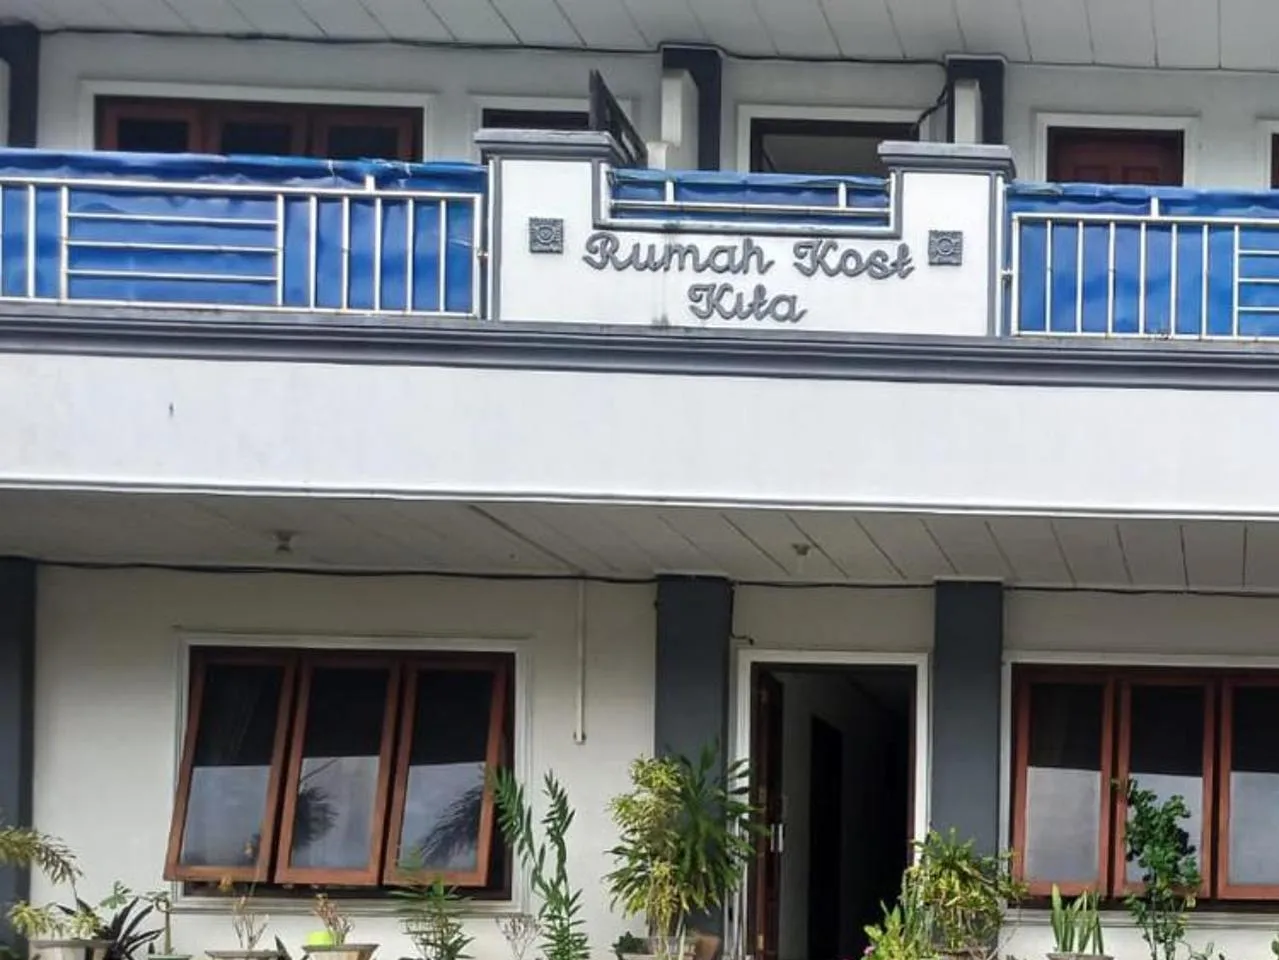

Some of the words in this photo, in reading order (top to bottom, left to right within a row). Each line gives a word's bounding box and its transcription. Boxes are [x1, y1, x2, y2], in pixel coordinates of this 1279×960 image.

[582, 231, 775, 276] Rumah
[792, 238, 916, 280] Kost
[687, 282, 807, 323] Kita
